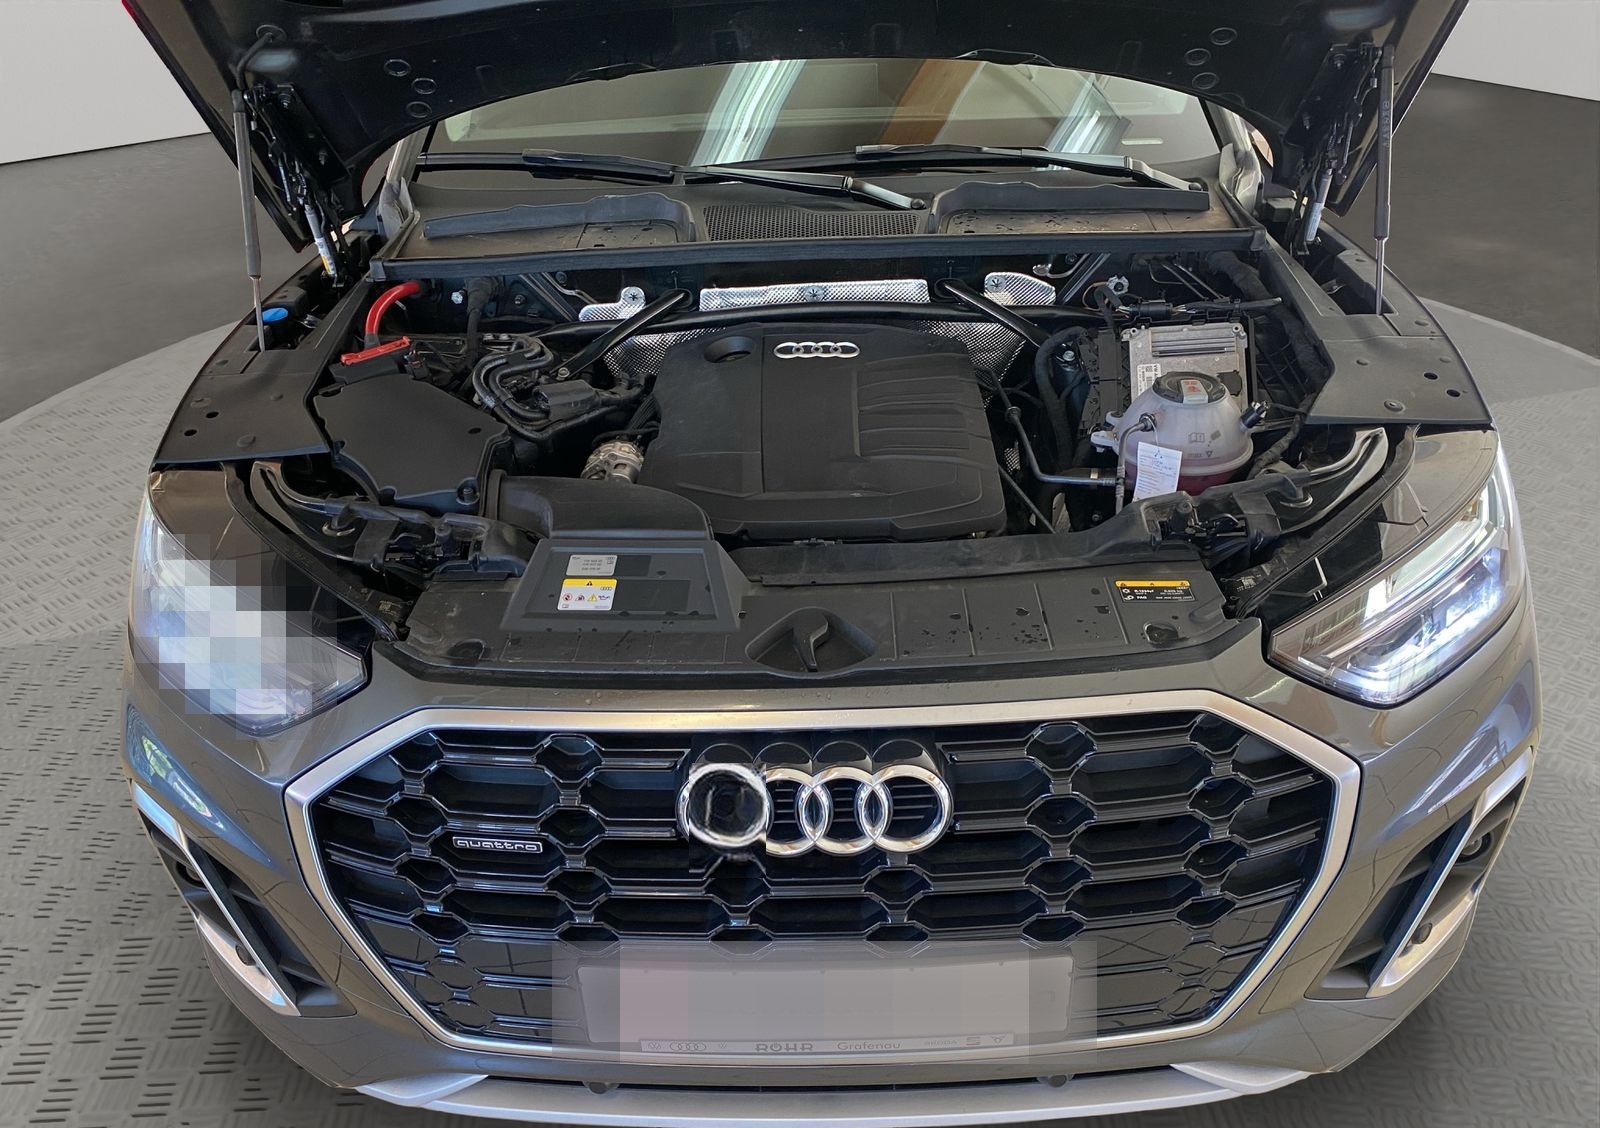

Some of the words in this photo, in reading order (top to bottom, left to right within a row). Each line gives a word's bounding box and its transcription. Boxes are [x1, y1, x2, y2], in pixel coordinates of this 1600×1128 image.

[457, 840, 537, 851] quattro
[755, 1042, 814, 1052] RÖHR
[837, 1041, 900, 1051] Grafenau
